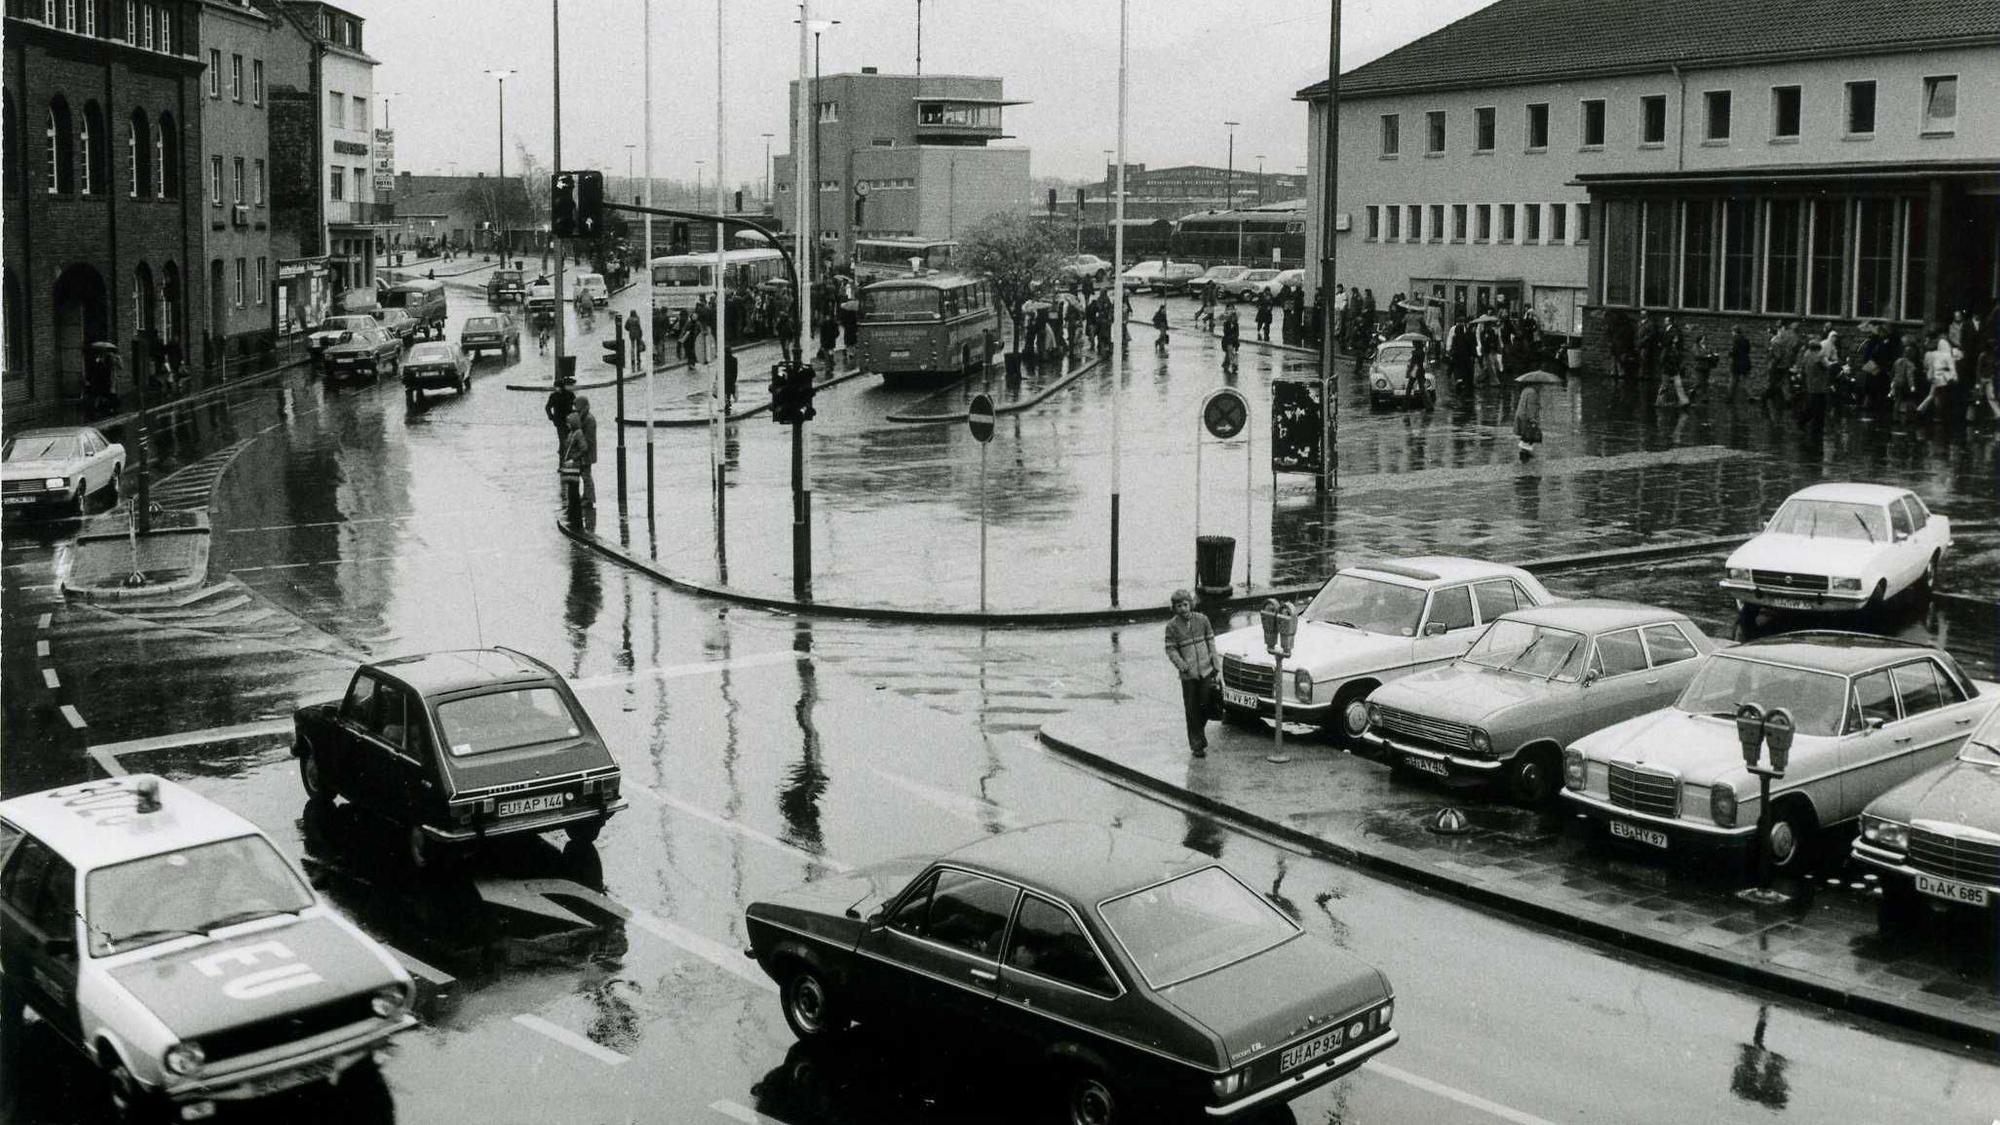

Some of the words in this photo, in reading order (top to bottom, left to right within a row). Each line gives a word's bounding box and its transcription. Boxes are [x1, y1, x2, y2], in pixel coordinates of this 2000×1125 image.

[544, 795, 561, 808] 144
[1960, 887, 1982, 902] 685
[190, 941, 327, 999] EU
[1322, 1031, 1342, 1053] 934
